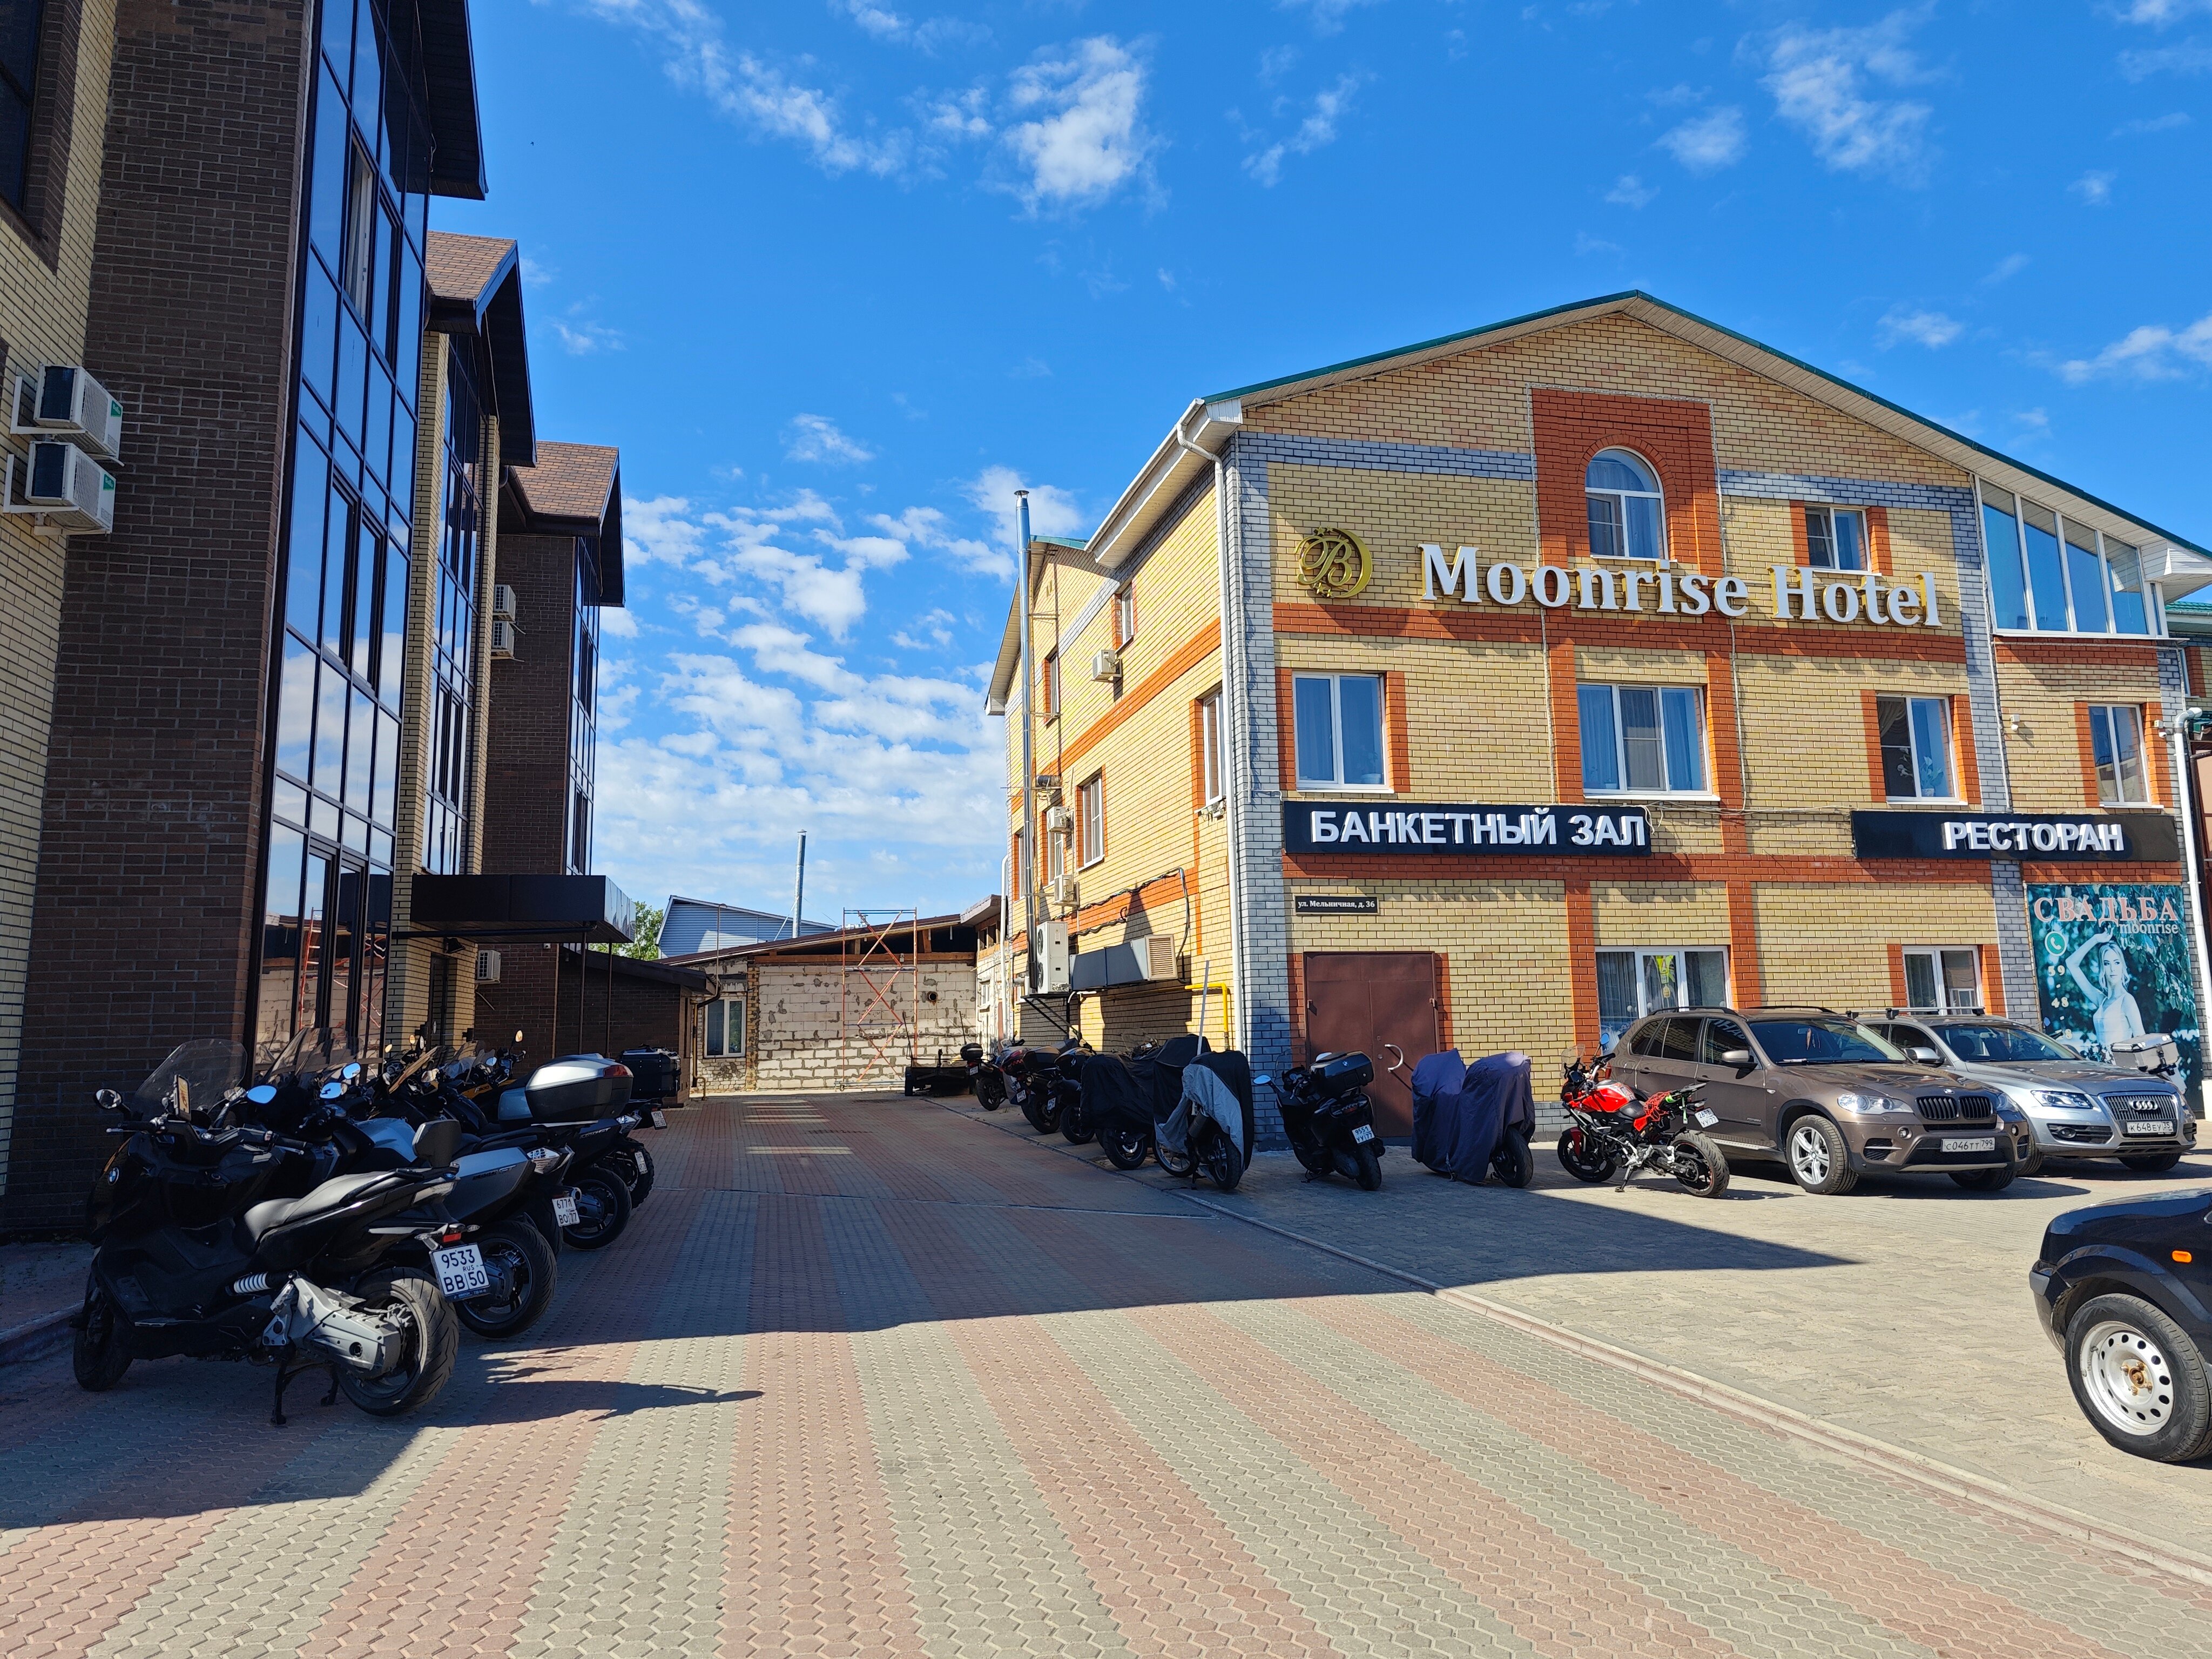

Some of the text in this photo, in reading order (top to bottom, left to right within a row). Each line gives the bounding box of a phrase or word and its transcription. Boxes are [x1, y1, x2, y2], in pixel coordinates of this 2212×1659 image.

[1418, 543, 1943, 628] Moonrise Hotel
[1311, 807, 1645, 847] БАНКЕТНЫЙ ЗАЛ
[1943, 822, 2125, 851] РЕСТОРАН
[1310, 900, 1357, 908] Мельничная,
[2034, 897, 2179, 927] СВАДЬБА
[2119, 921, 2179, 934] moonrise
[2051, 996, 2069, 1008] 48
[569, 1212, 577, 1223] 77
[441, 1249, 475, 1269] 9533
[468, 1270, 485, 1286] 50
